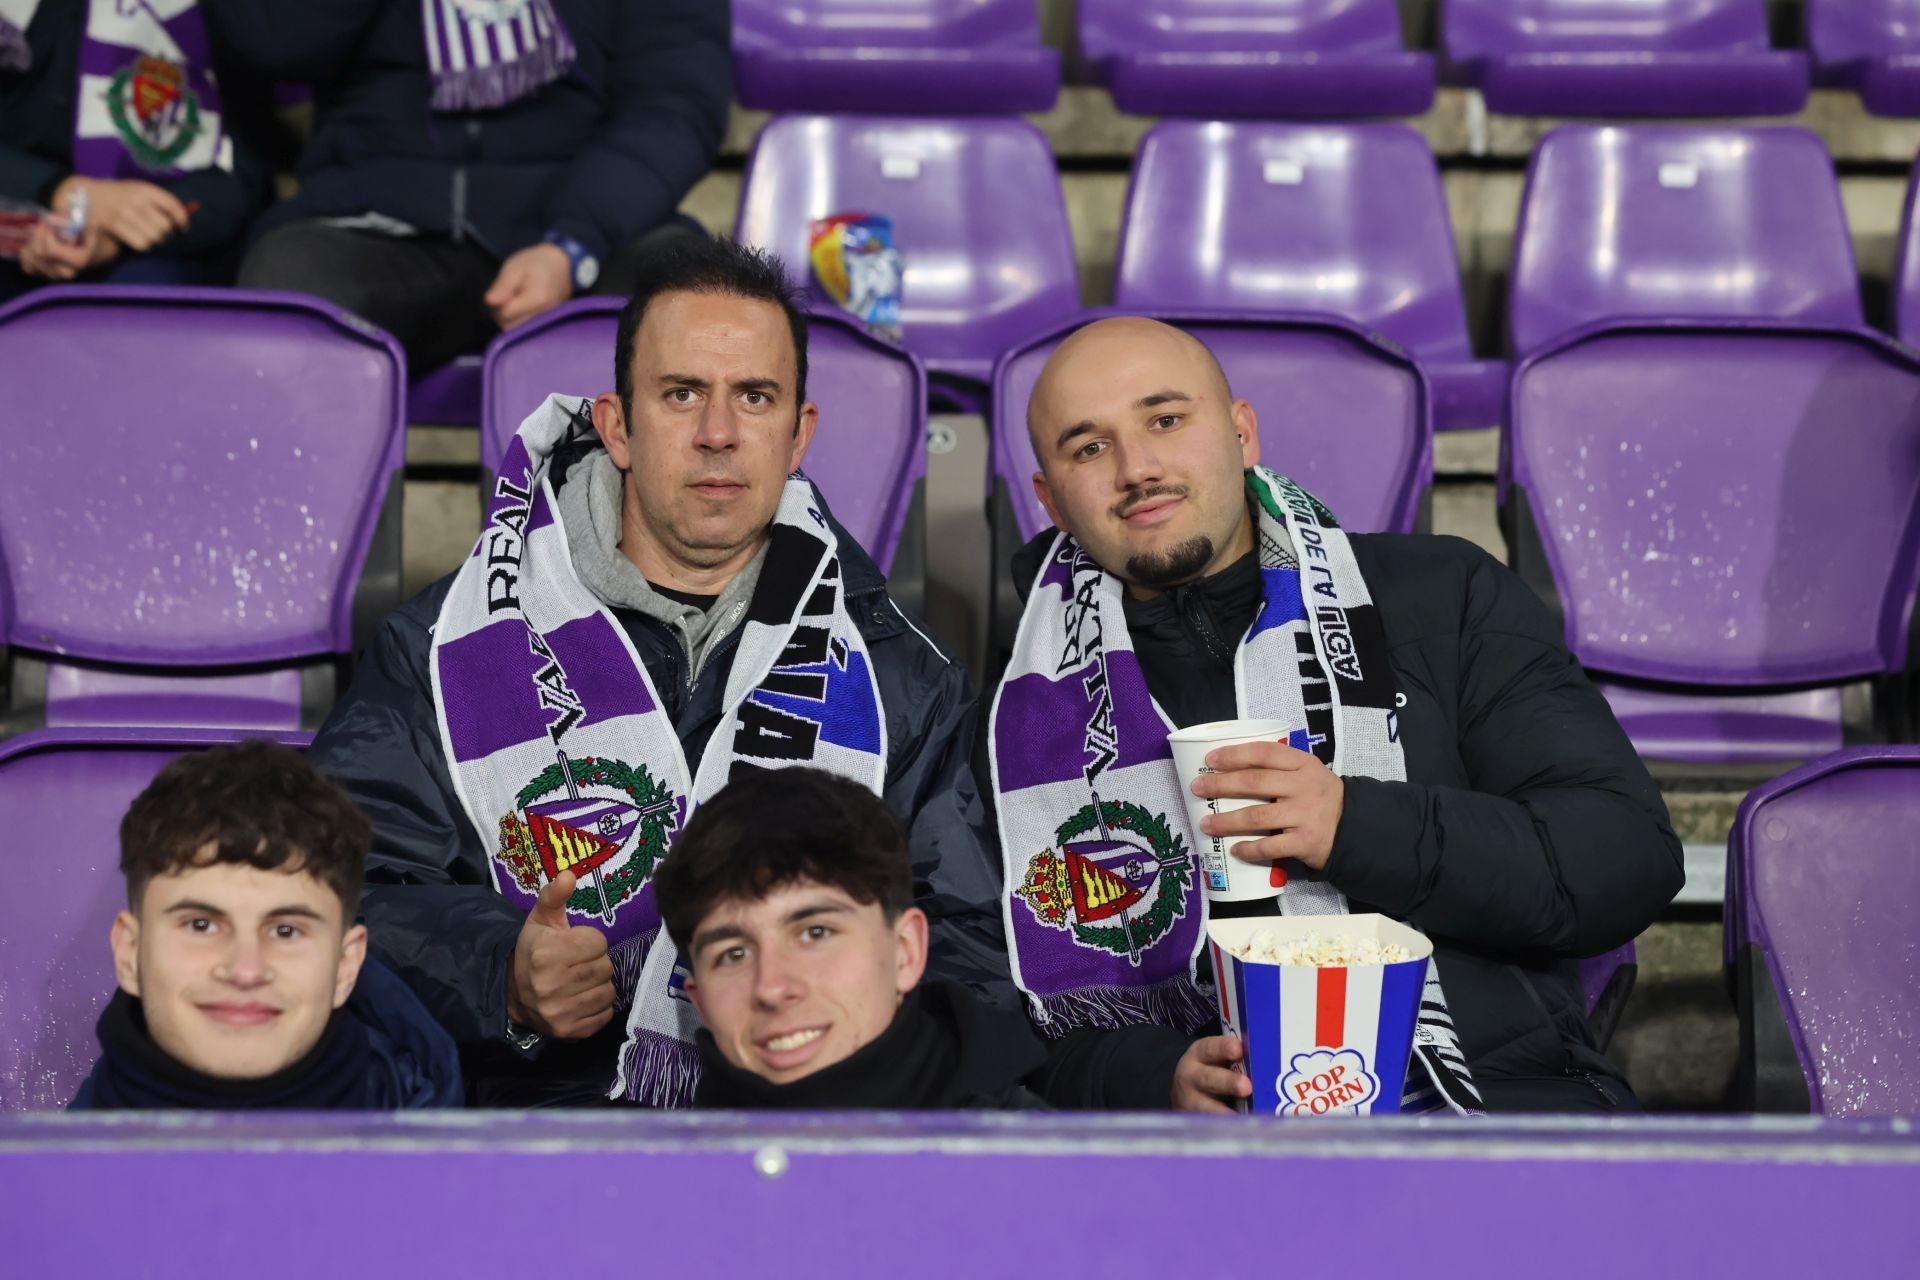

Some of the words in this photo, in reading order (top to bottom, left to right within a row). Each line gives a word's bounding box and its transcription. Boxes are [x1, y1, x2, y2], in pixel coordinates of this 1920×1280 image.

[487, 467, 533, 616] REAL
[1293, 1077, 1364, 1117] CORN
[1294, 1065, 1345, 1101] POP
